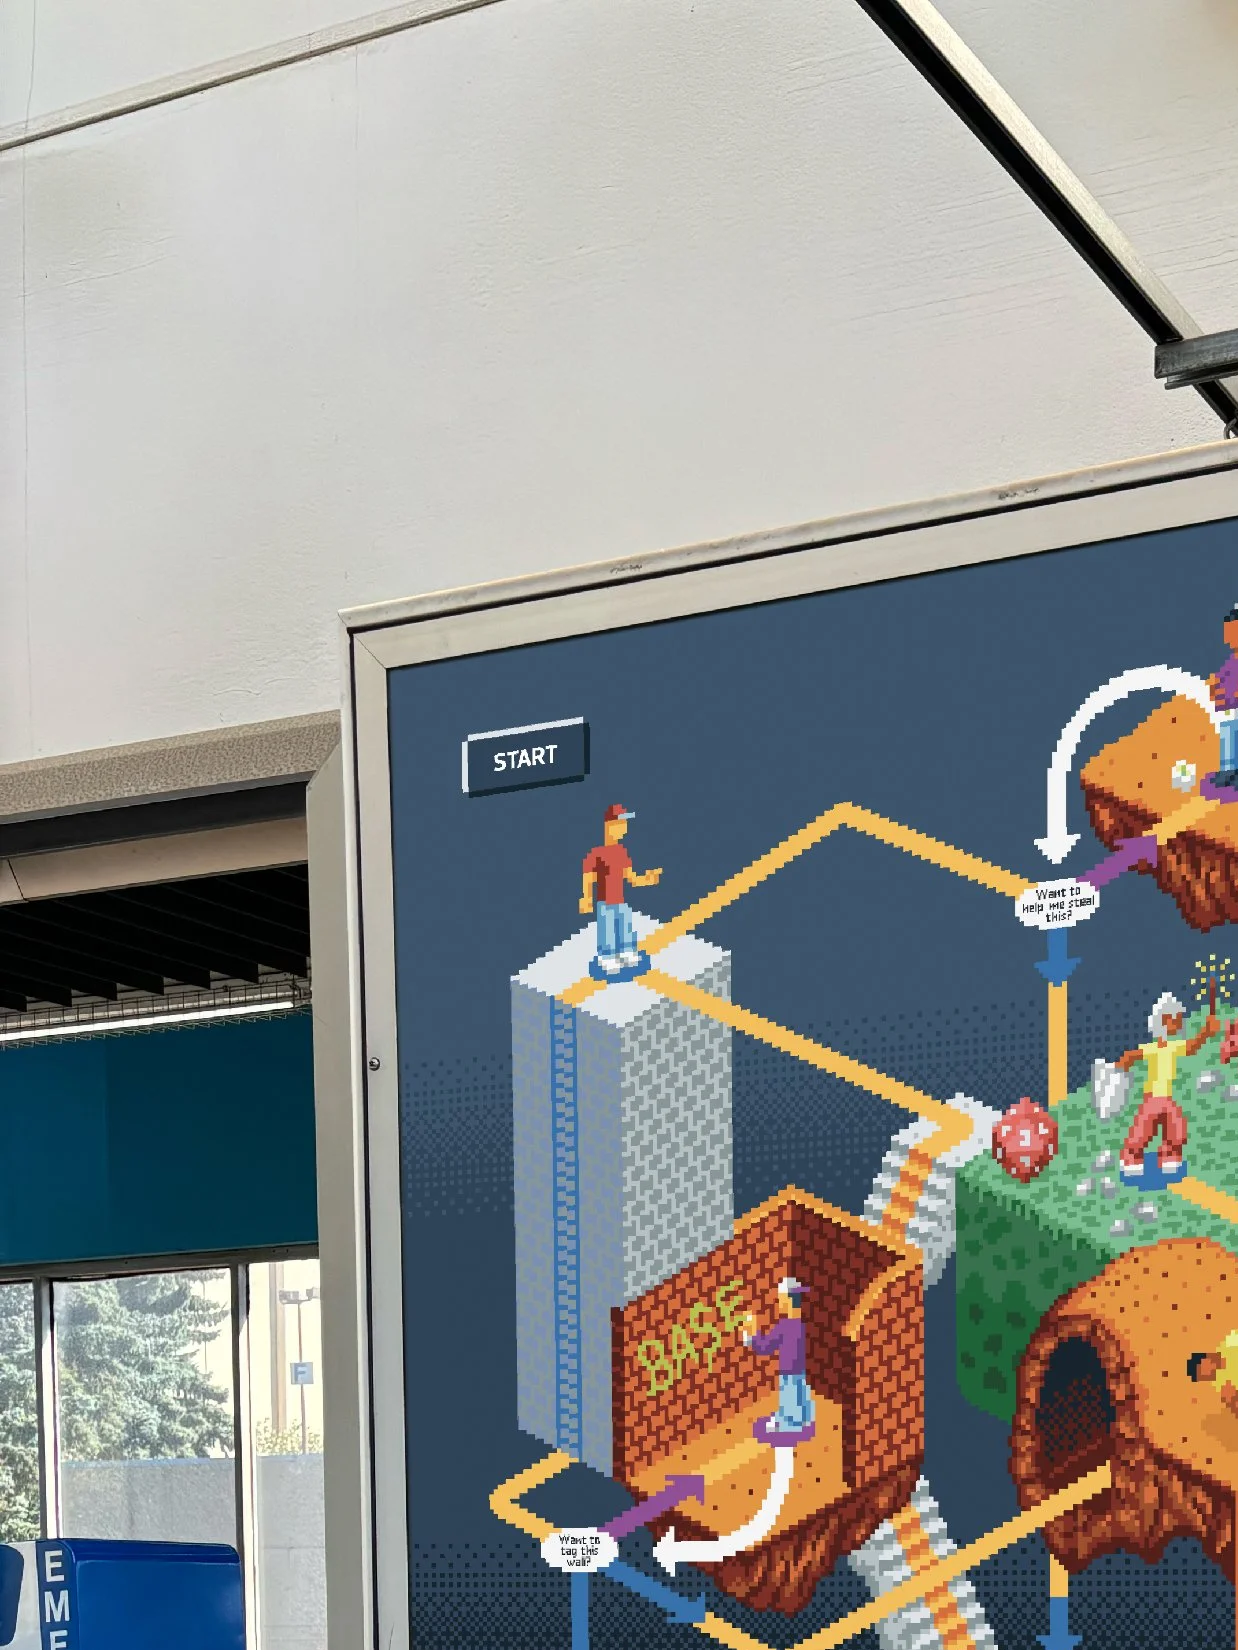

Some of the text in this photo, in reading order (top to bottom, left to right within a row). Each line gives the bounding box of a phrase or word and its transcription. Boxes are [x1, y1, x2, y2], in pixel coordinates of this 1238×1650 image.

[493, 744, 557, 772] START
[1035, 886, 1081, 901] Want to
[1022, 895, 1095, 915] help me steal
[1046, 910, 1072, 923] this?
[559, 1534, 601, 1545] Want to
[561, 1545, 599, 1558] tag this
[566, 1556, 591, 1567] wall?
